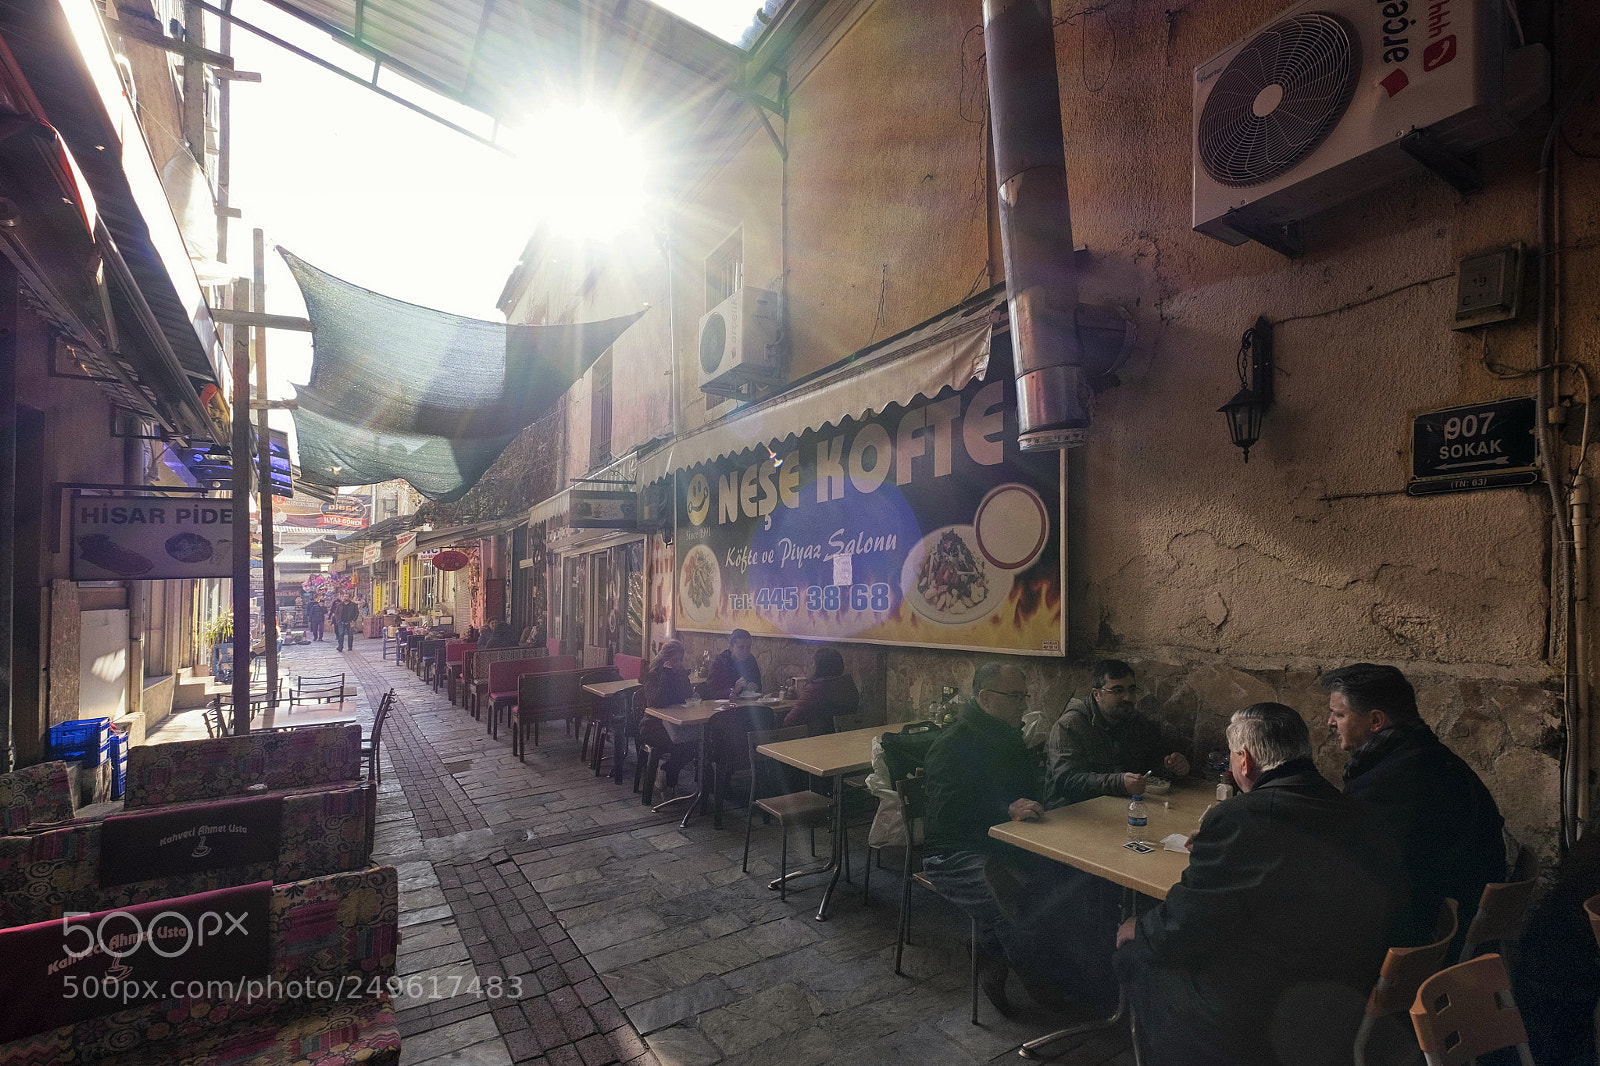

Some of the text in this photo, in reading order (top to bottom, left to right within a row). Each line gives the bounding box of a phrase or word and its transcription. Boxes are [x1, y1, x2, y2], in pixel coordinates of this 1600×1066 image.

[1444, 411, 1496, 440] 907
[1439, 438, 1503, 460] SOKAK
[718, 450, 800, 531] NEŞE
[81, 503, 234, 525] HİSAR PİDE
[725, 529, 897, 577] Köfte ve Piyaz Salonu
[729, 583, 890, 613] Tel: 445 38 68
[158, 823, 248, 848] Kahveci Ahmet Usta
[157, 924, 188, 940] Usta
